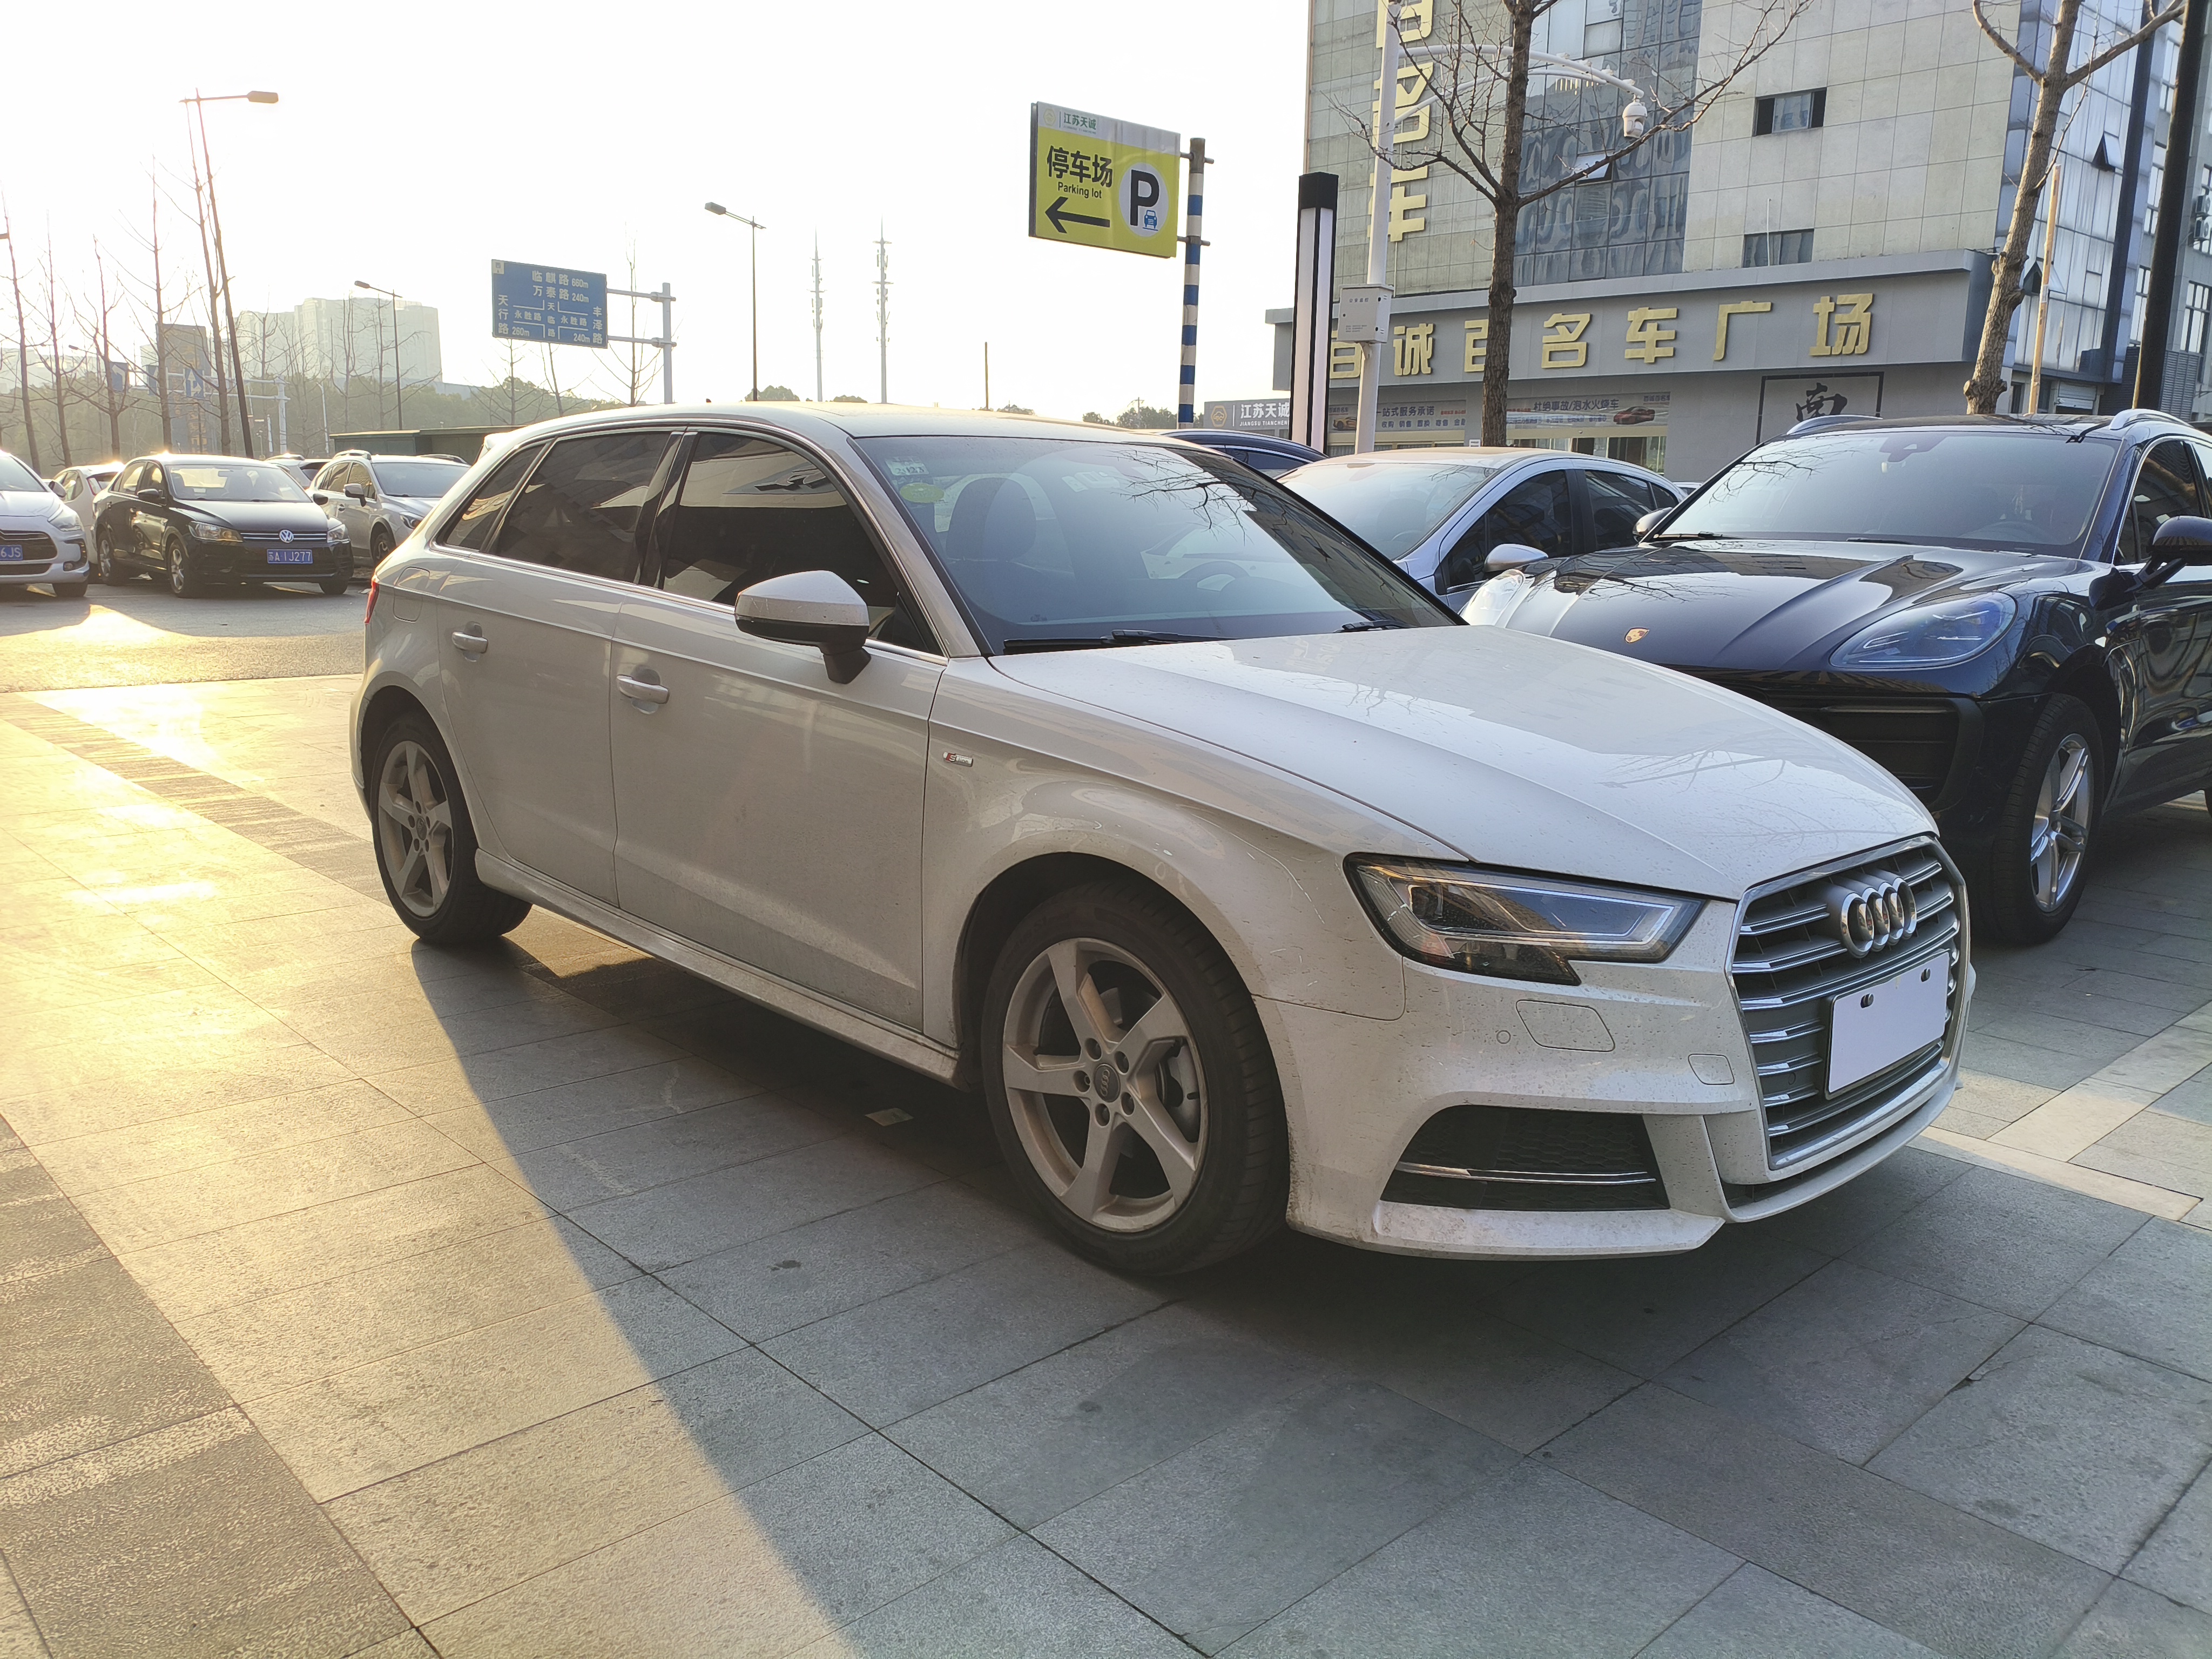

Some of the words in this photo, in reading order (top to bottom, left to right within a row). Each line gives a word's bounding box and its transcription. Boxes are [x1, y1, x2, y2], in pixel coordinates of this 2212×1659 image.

[1064, 112, 1096, 130] 江苏天诚
[1047, 145, 1113, 188] 停车场
[1057, 181, 1090, 199] Parking
[1091, 187, 1102, 199] lot
[1130, 169, 1159, 226] P
[532, 270, 569, 286] 临麒路
[571, 278, 589, 288] 660m
[532, 285, 569, 300] 万泰路
[572, 293, 589, 303] 240m
[498, 294, 509, 334] 天行路
[514, 309, 542, 321] 永胜路
[547, 302, 555, 337] 天临路
[561, 315, 587, 326] 永胜路
[512, 326, 530, 336] 260m
[592, 306, 603, 344] 丰泽路
[574, 333, 590, 343] 240m
[1240, 402, 1290, 419] 江苏天诚
